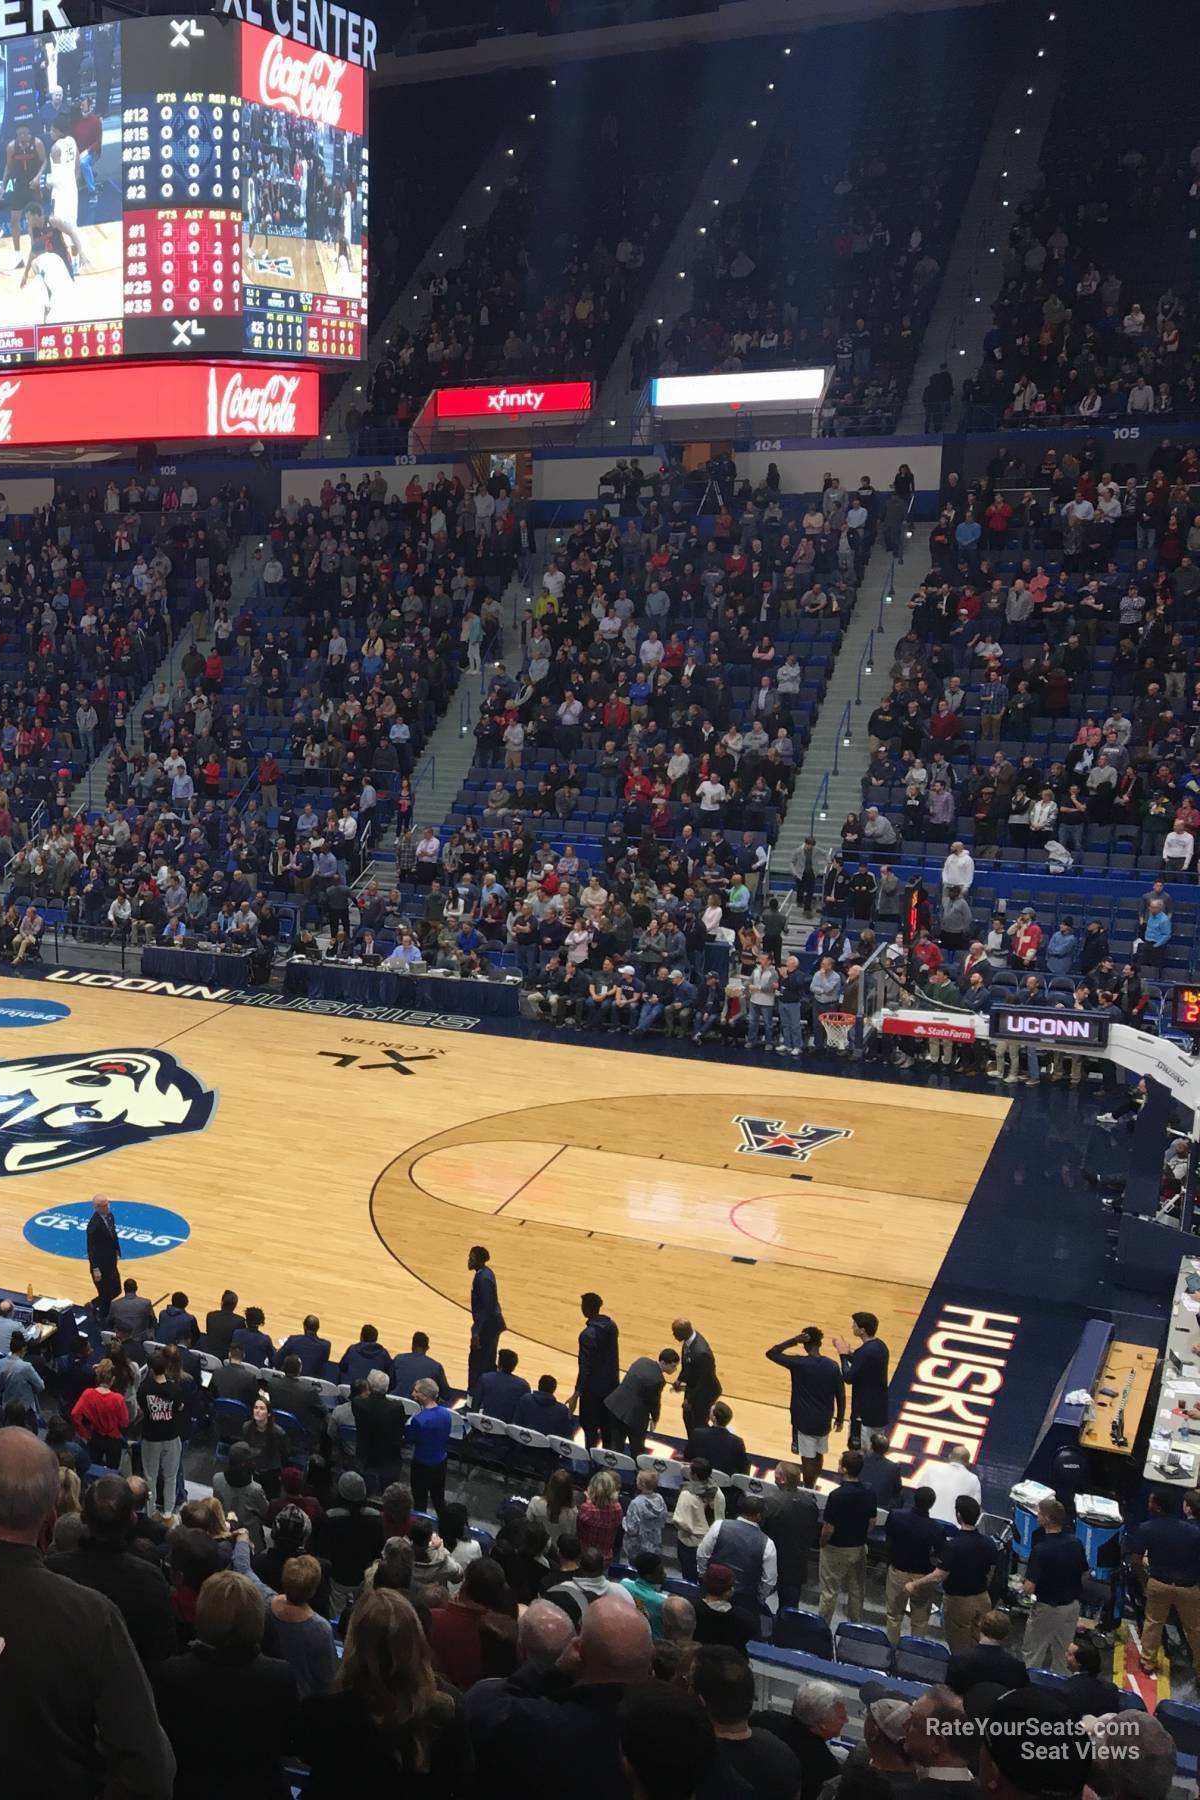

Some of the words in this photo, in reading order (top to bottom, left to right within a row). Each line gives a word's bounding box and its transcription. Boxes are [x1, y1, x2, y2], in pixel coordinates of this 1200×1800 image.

[170, 19, 205, 47] XL
[271, 0, 378, 72] CENTER
[259, 34, 347, 126] Coca-Cola
[157, 93, 177, 104] PTS
[184, 92, 204, 103] AST
[123, 107, 148, 123] #12
[161, 106, 173, 120] 0
[188, 105, 200, 120] 0
[213, 106, 223, 121] 0
[232, 109, 240, 123] 0
[123, 127, 149, 142] #15
[161, 125, 173, 140] 0
[188, 125, 200, 139] 0
[213, 126, 223, 140] 0
[232, 128, 240, 142] 0
[122, 146, 151, 162] #25
[161, 145, 173, 159] 0
[188, 144, 200, 158] 0
[232, 147, 240, 161] 0
[128, 165, 145, 180] #1
[161, 164, 173, 178] 0
[188, 163, 200, 178] 0
[232, 166, 240, 180] 0
[126, 185, 146, 199] #2
[161, 183, 173, 197] 0
[188, 182, 200, 197] 0
[213, 183, 223, 197] 0
[232, 185, 240, 199] 0
[157, 210, 177, 220] PTS
[184, 210, 204, 220] AST
[129, 223, 145, 238] #1
[162, 222, 173, 237] 2
[188, 222, 200, 236] 0
[162, 241, 174, 255] 0
[188, 241, 200, 255] 0
[214, 241, 222, 255] 2
[232, 242, 240, 256] 0
[162, 260, 174, 274] 0
[213, 260, 223, 274] 0
[232, 261, 240, 274] 0
[124, 280, 152, 295] #25
[162, 279, 174, 293] 0
[188, 279, 200, 293] 0
[213, 279, 223, 293] 0
[232, 280, 240, 293] 0
[162, 298, 174, 312] 0
[188, 297, 200, 311] 0
[213, 297, 223, 311] 0
[172, 319, 206, 346] XL
[221, 372, 301, 433] Coca-Cola
[487, 389, 544, 411] xfinity
[1113, 427, 1140, 440] 105
[754, 440, 781, 451] 104
[394, 455, 417, 465] 103
[159, 466, 177, 476] 102
[44, 970, 230, 1001] UCONN
[220, 990, 481, 1031] HUSKIES
[1007, 1015, 1090, 1038] UCONN
[341, 1036, 419, 1051] CENTER
[34, 1215, 187, 1247] gens3D
